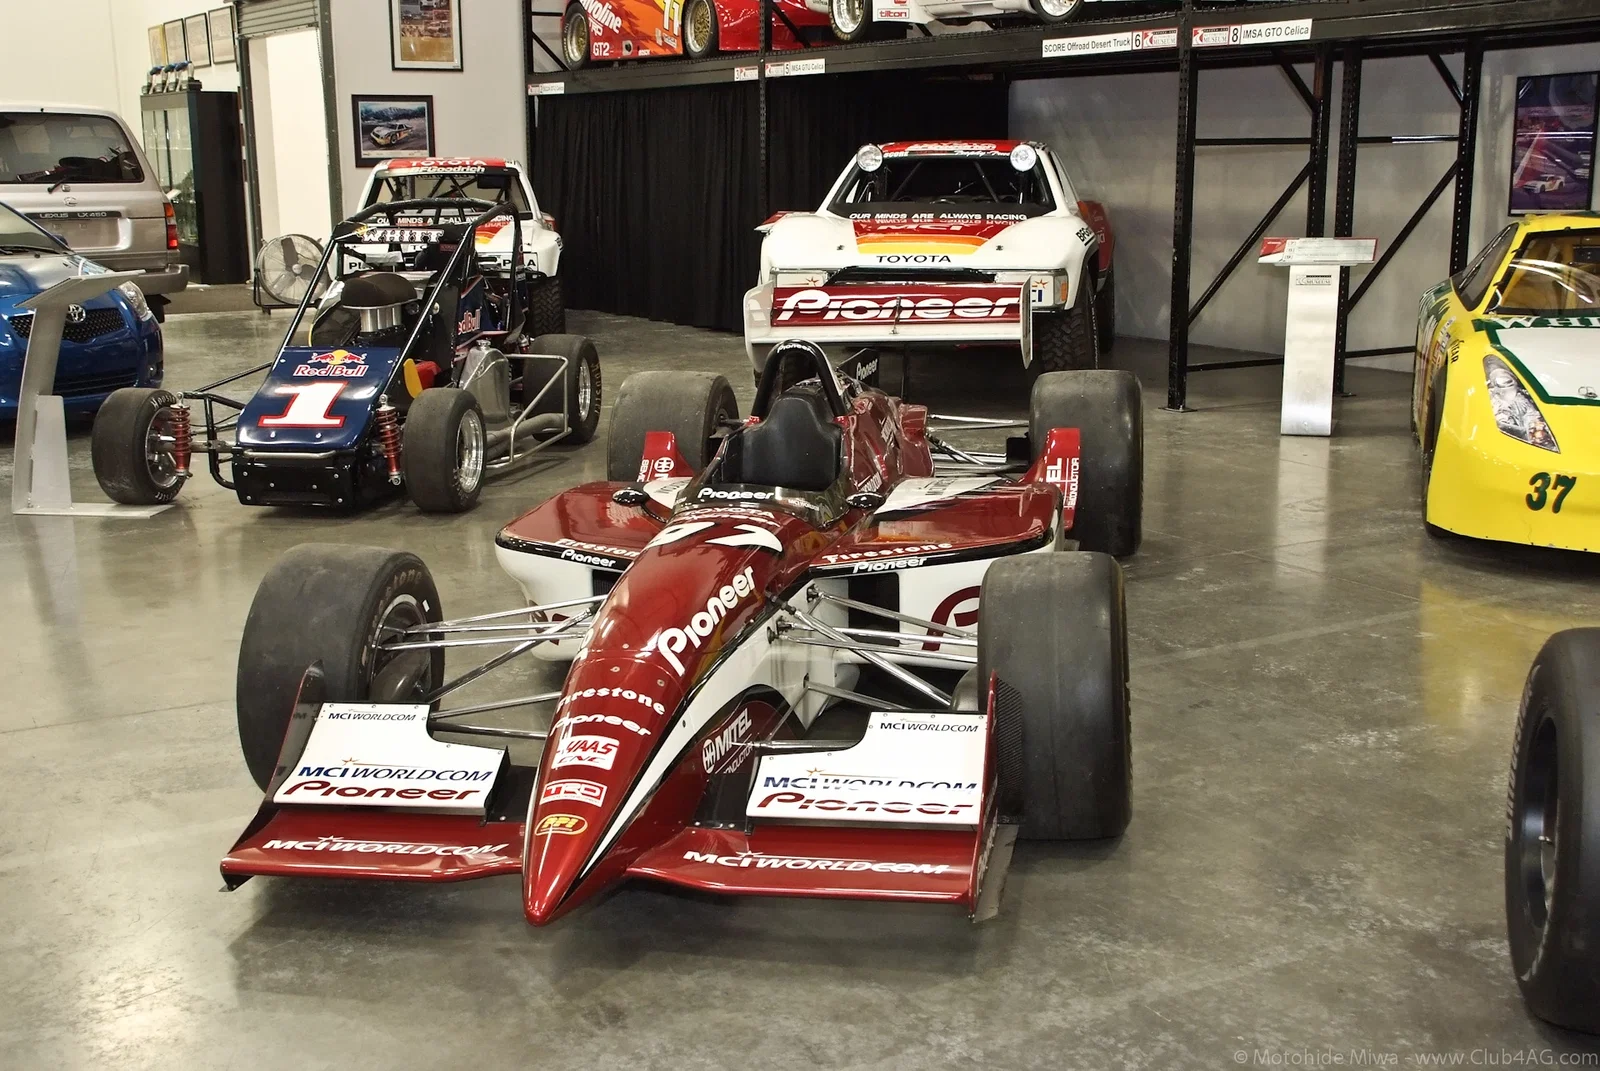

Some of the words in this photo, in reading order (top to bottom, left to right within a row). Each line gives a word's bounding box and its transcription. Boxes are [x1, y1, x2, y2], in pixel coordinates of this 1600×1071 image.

[1231, 28, 1239, 42] 8
[1243, 29, 1263, 39] IMSA
[1264, 27, 1282, 37] GTO
[1284, 25, 1310, 35] Celica
[1044, 43, 1066, 53] SCORE
[1067, 41, 1090, 51] Offroad
[1092, 40, 1112, 49] Desert
[1113, 38, 1131, 47] Truck
[1134, 33, 1141, 48] 6
[593, 42, 610, 56] GT2
[397, 216, 424, 225] MINDS
[876, 255, 951, 263] TOYOTA
[777, 288, 1020, 322] Pioneer
[776, 342, 813, 354] Pioneer
[293, 364, 332, 377] Red
[331, 364, 369, 377] Bull
[856, 358, 878, 381] Pioneer
[258, 380, 349, 428] 1
[697, 487, 775, 500] Pioneer
[1525, 471, 1577, 514] 37
[685, 506, 776, 519] TOYOTA
[554, 538, 642, 558] Fireston
[822, 543, 953, 564] Firestone
[561, 549, 616, 567] Pioneer
[852, 556, 930, 573] Pioneer
[657, 565, 755, 677] Pioneer
[715, 707, 752, 761] MITEL
[283, 780, 481, 800] Pioneer
[546, 782, 601, 797] TRD
[757, 791, 974, 815] Pioneer
